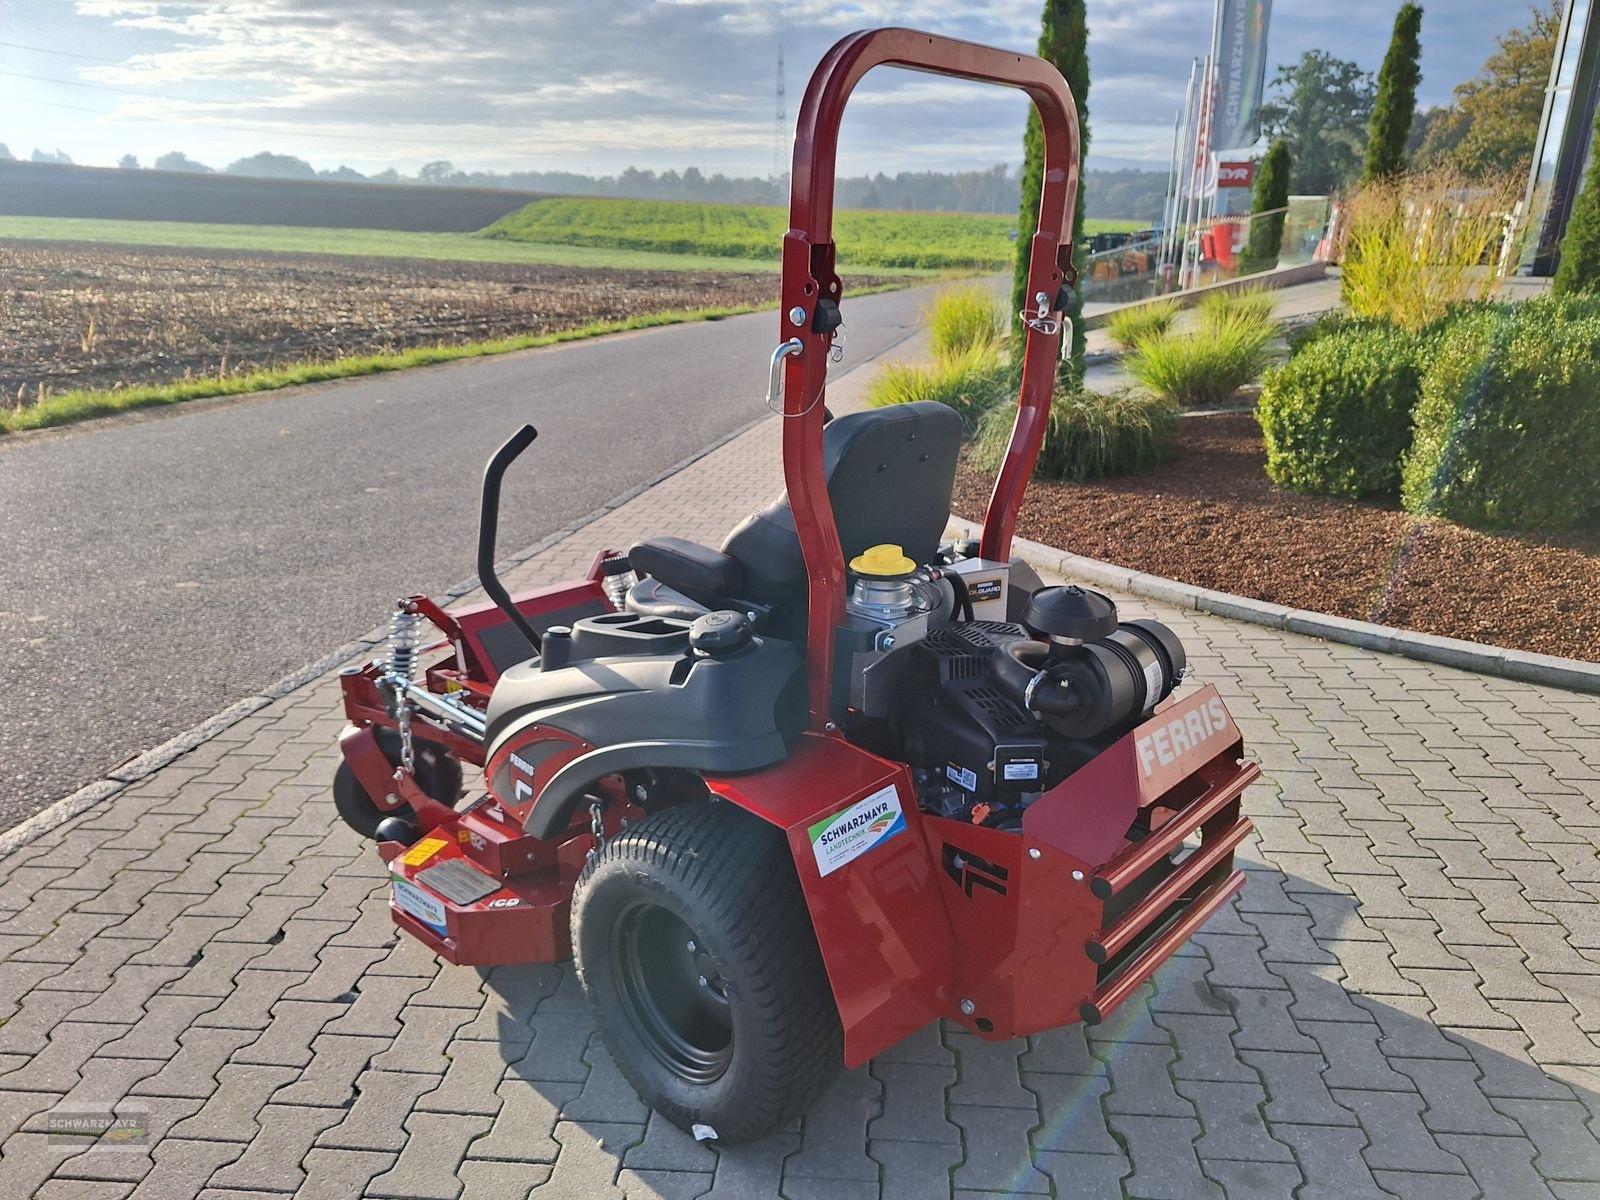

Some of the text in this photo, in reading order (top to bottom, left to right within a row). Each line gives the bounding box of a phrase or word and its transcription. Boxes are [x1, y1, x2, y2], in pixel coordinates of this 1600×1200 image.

[1136, 696, 1227, 779] FERRIS
[821, 802, 888, 845] SCHWARZMAYR
[825, 828, 867, 855] LANDTECHNIK
